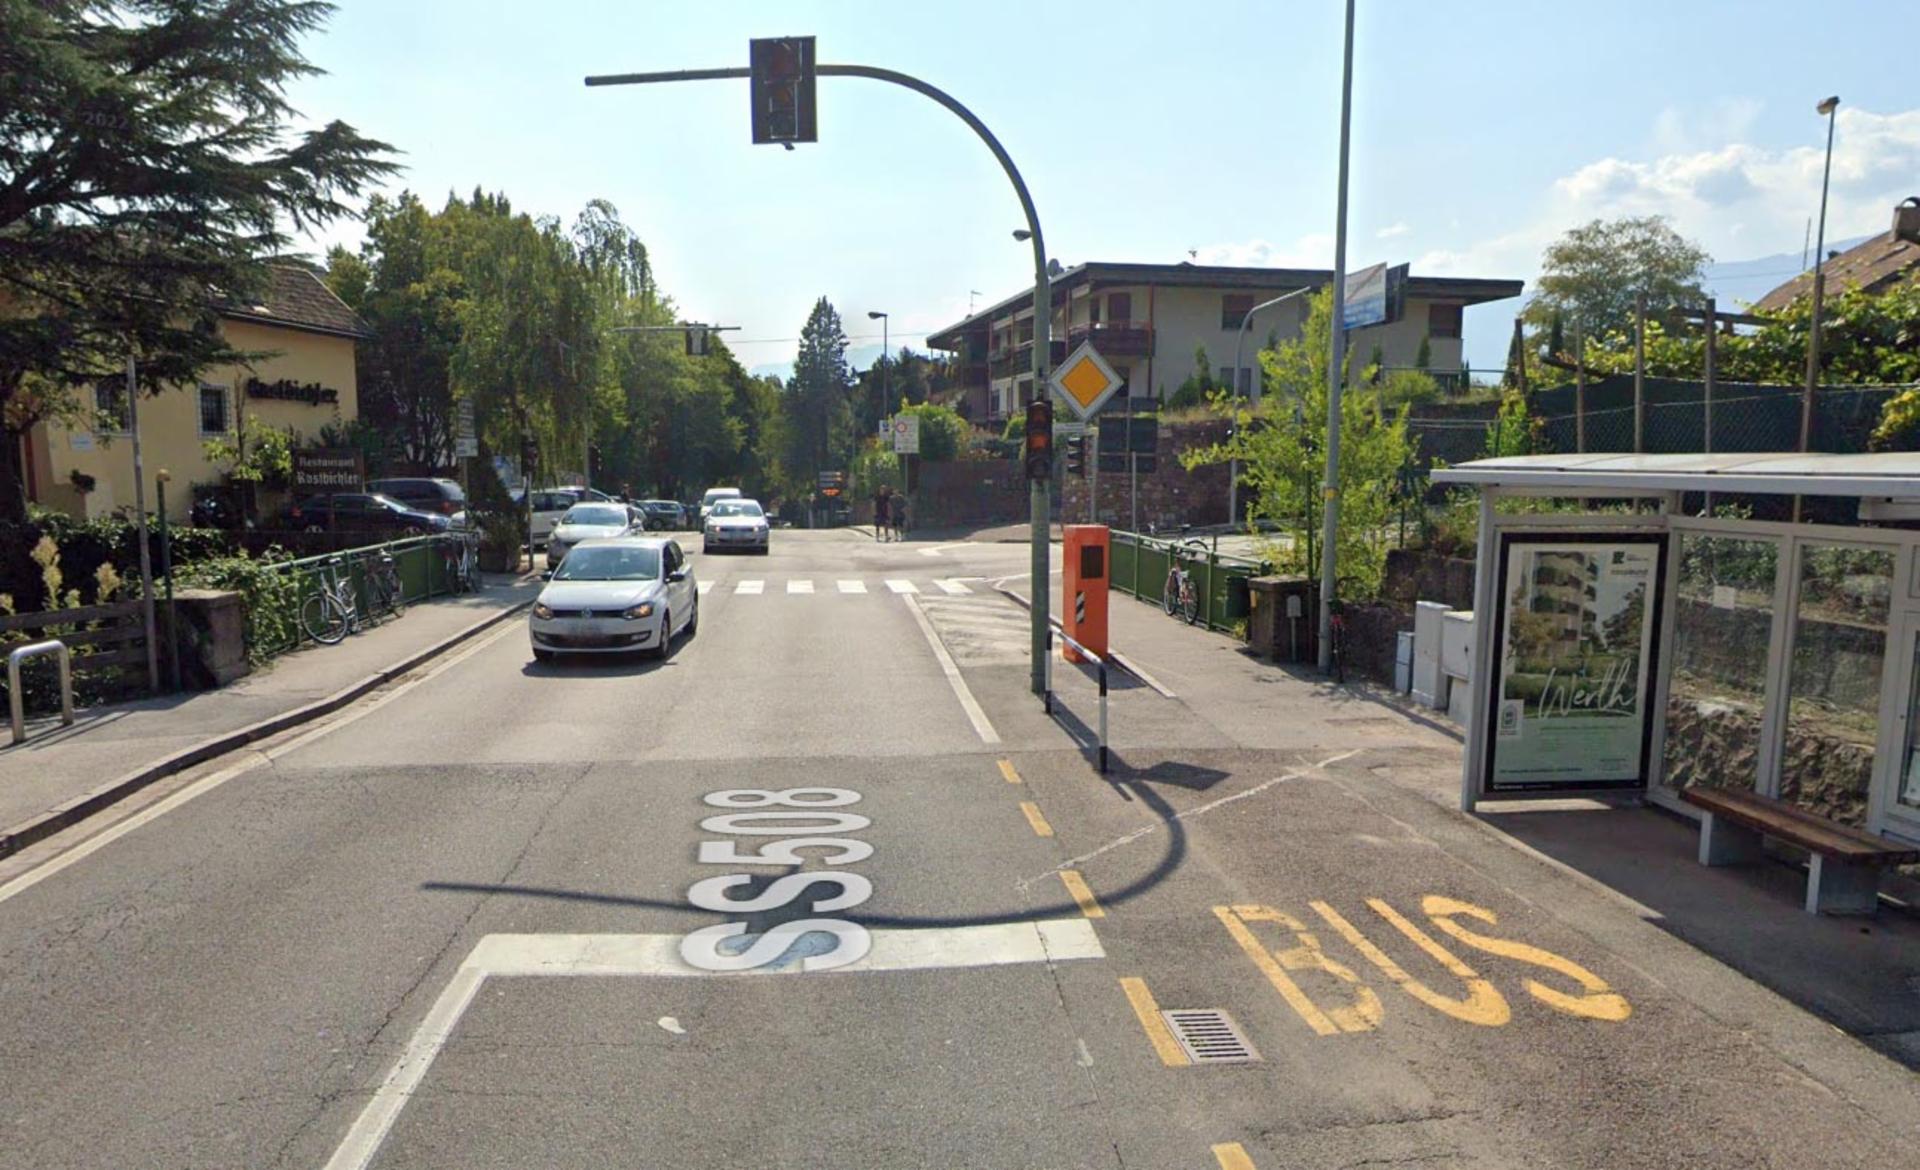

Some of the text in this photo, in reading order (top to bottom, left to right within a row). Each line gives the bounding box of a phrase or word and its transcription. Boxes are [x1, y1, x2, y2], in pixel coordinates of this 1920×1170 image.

[299, 456, 355, 468] Restaurant
[1538, 658, 1638, 719] Werth
[1211, 895, 1632, 1036] BUS
